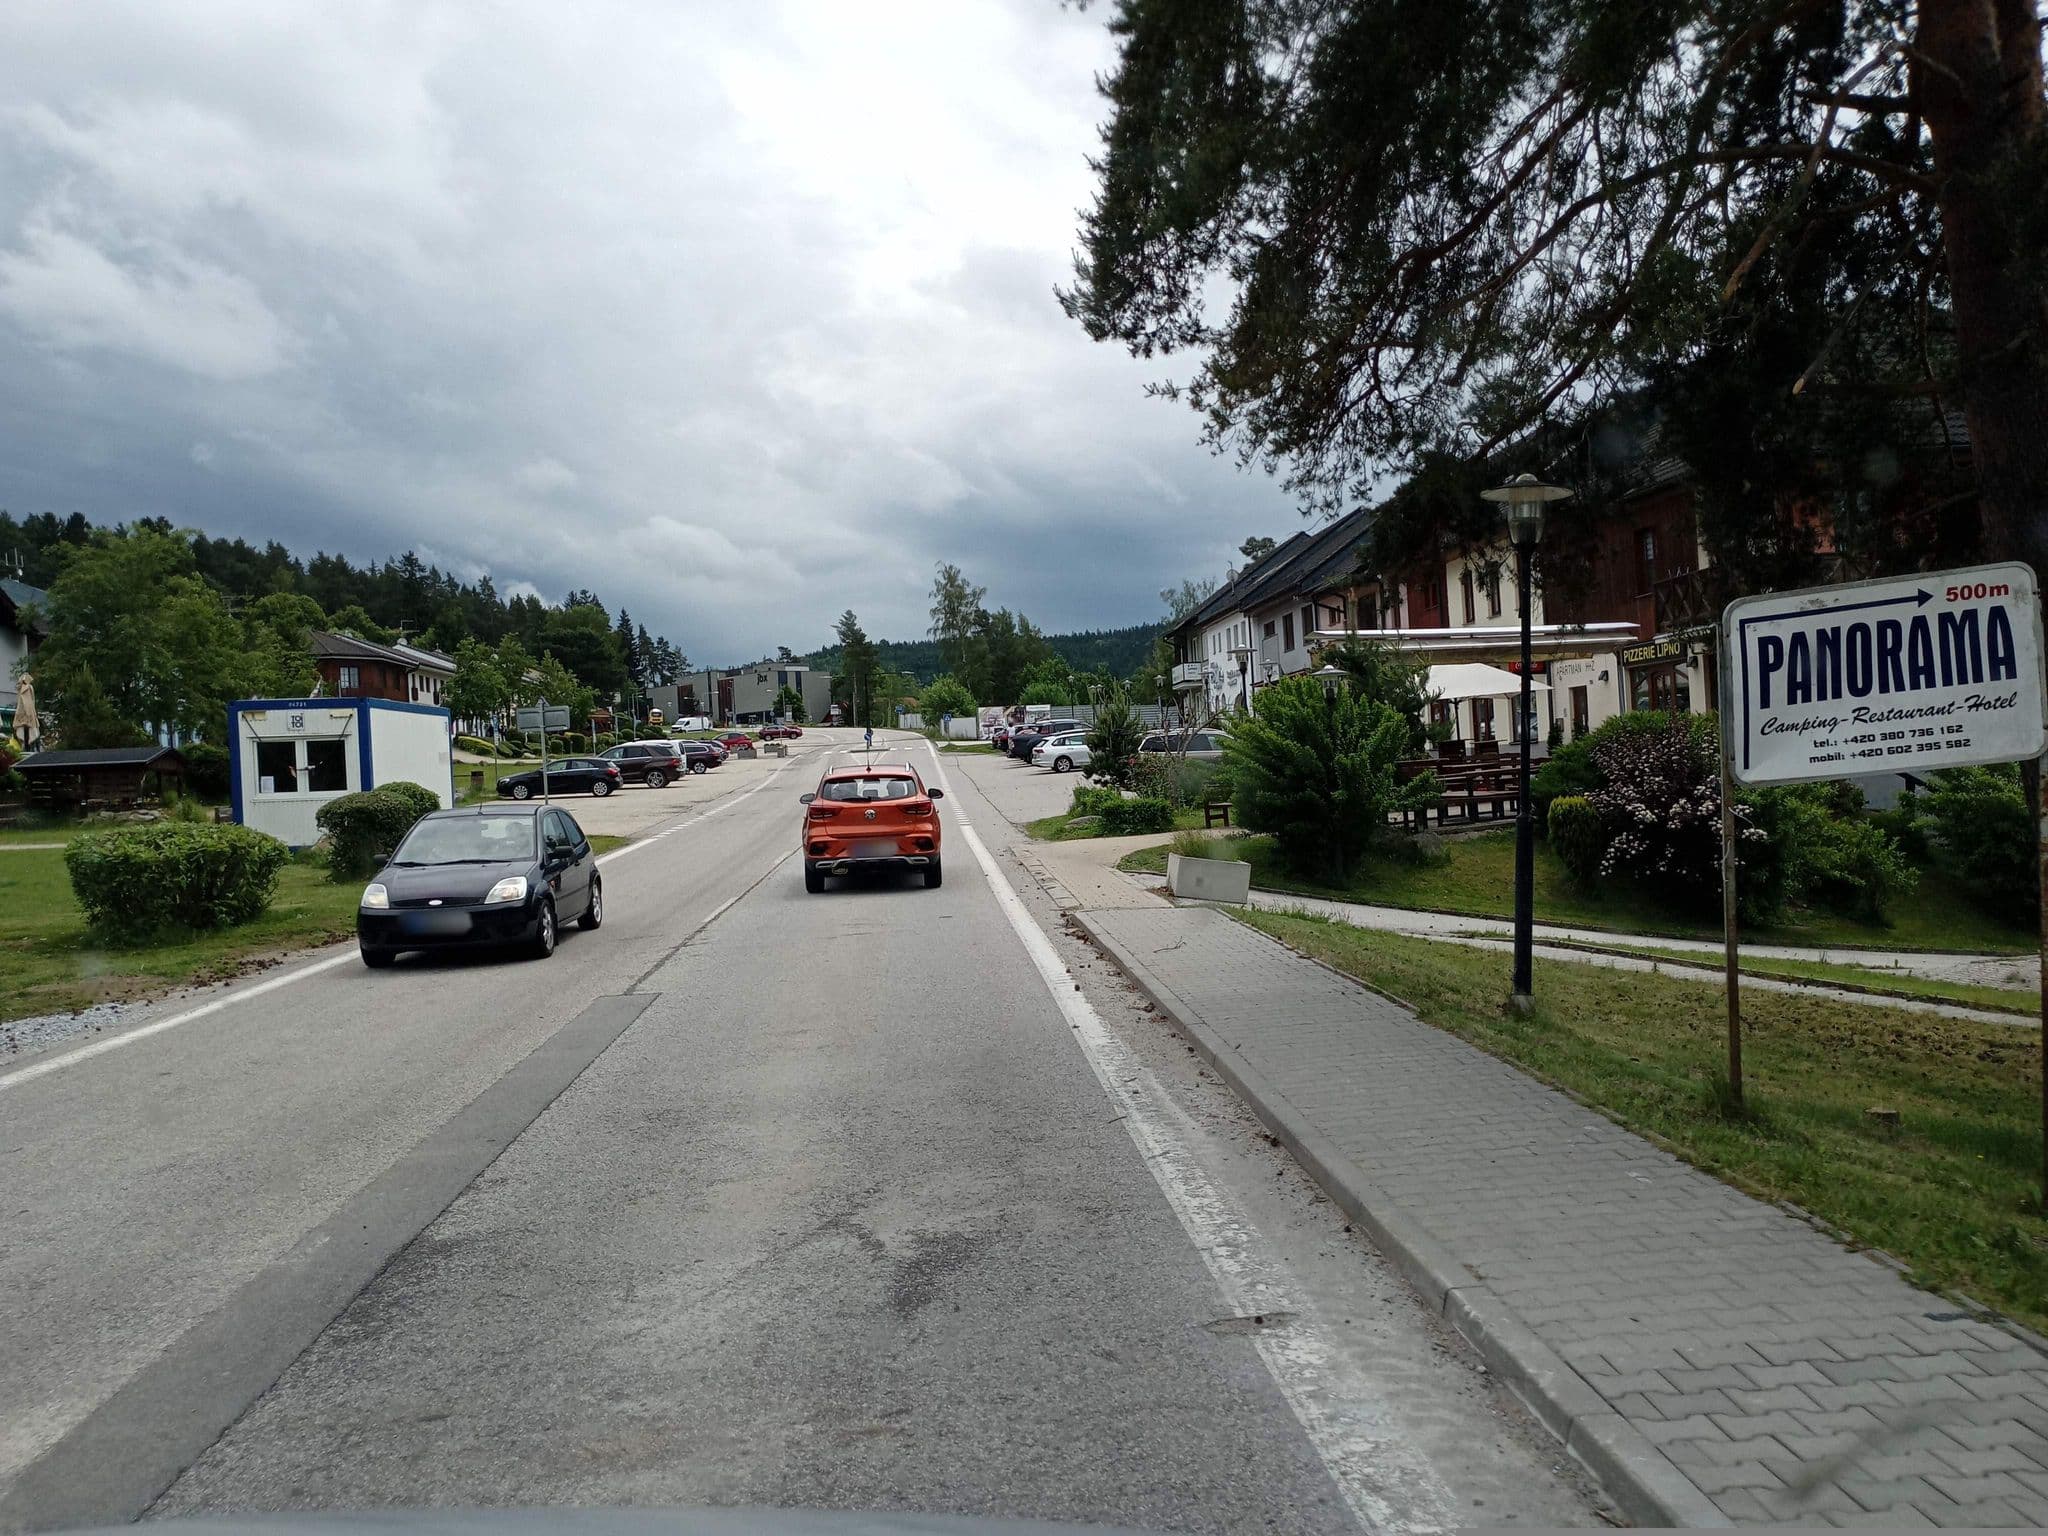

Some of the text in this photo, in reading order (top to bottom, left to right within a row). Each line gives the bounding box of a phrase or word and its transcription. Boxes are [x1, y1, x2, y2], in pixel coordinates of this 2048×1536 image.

[1945, 583, 2010, 602] 500m
[1623, 642, 1681, 662] PIZZERIE LIPNO
[1757, 605, 2018, 709] PANORAMA
[1760, 692, 2018, 736] Camping-Restaurant-Hotel
[1813, 724, 1964, 748] tel.: +420 380 736 162
[1809, 738, 1971, 763] mobil: +420 602 395 582
